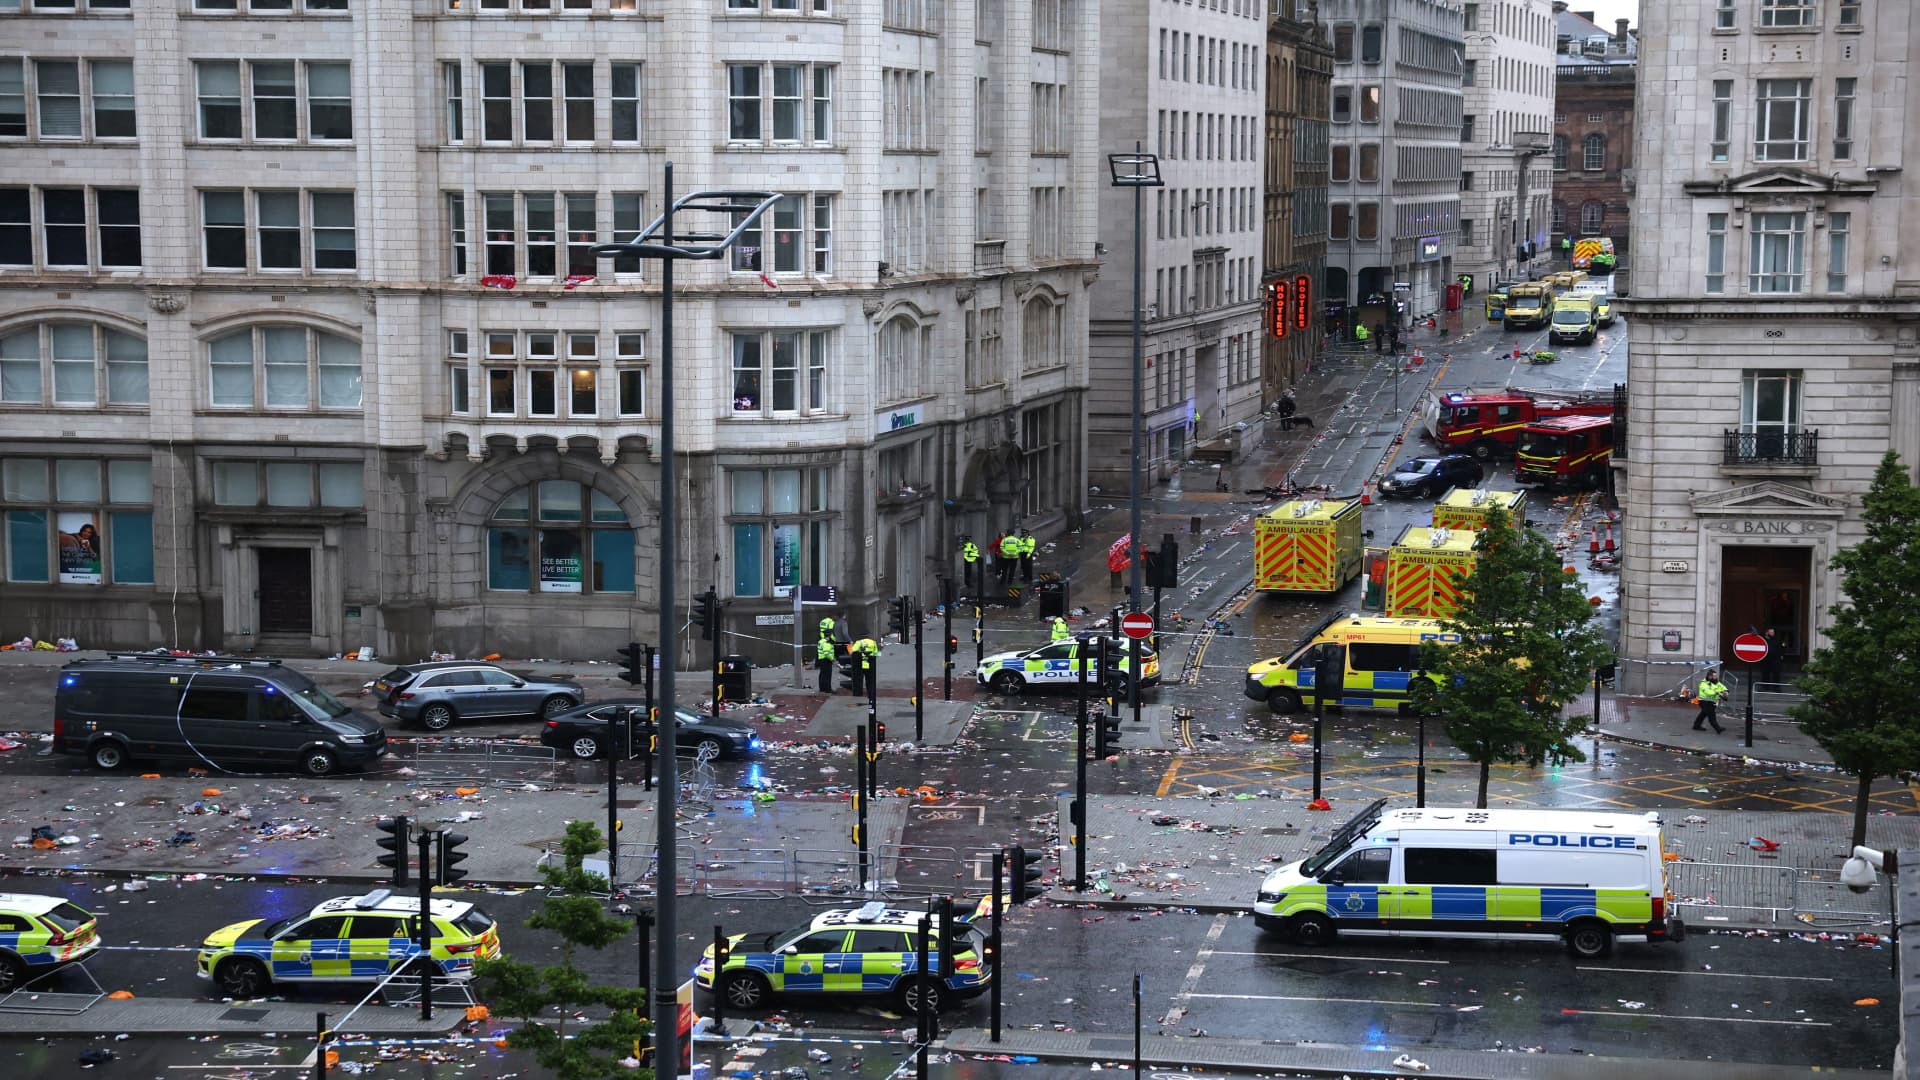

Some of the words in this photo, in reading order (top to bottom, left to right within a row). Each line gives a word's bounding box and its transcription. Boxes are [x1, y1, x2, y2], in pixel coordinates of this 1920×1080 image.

[1298, 279, 1306, 327] HOOTERS
[1276, 285, 1284, 336] HOOTERS
[1444, 513, 1486, 521] AMBULA
[1267, 526, 1325, 534] AMBULANCE
[1744, 521, 1792, 534] BANK
[1402, 556, 1464, 566] AMBULANCE
[1509, 833, 1636, 848] POLICE
